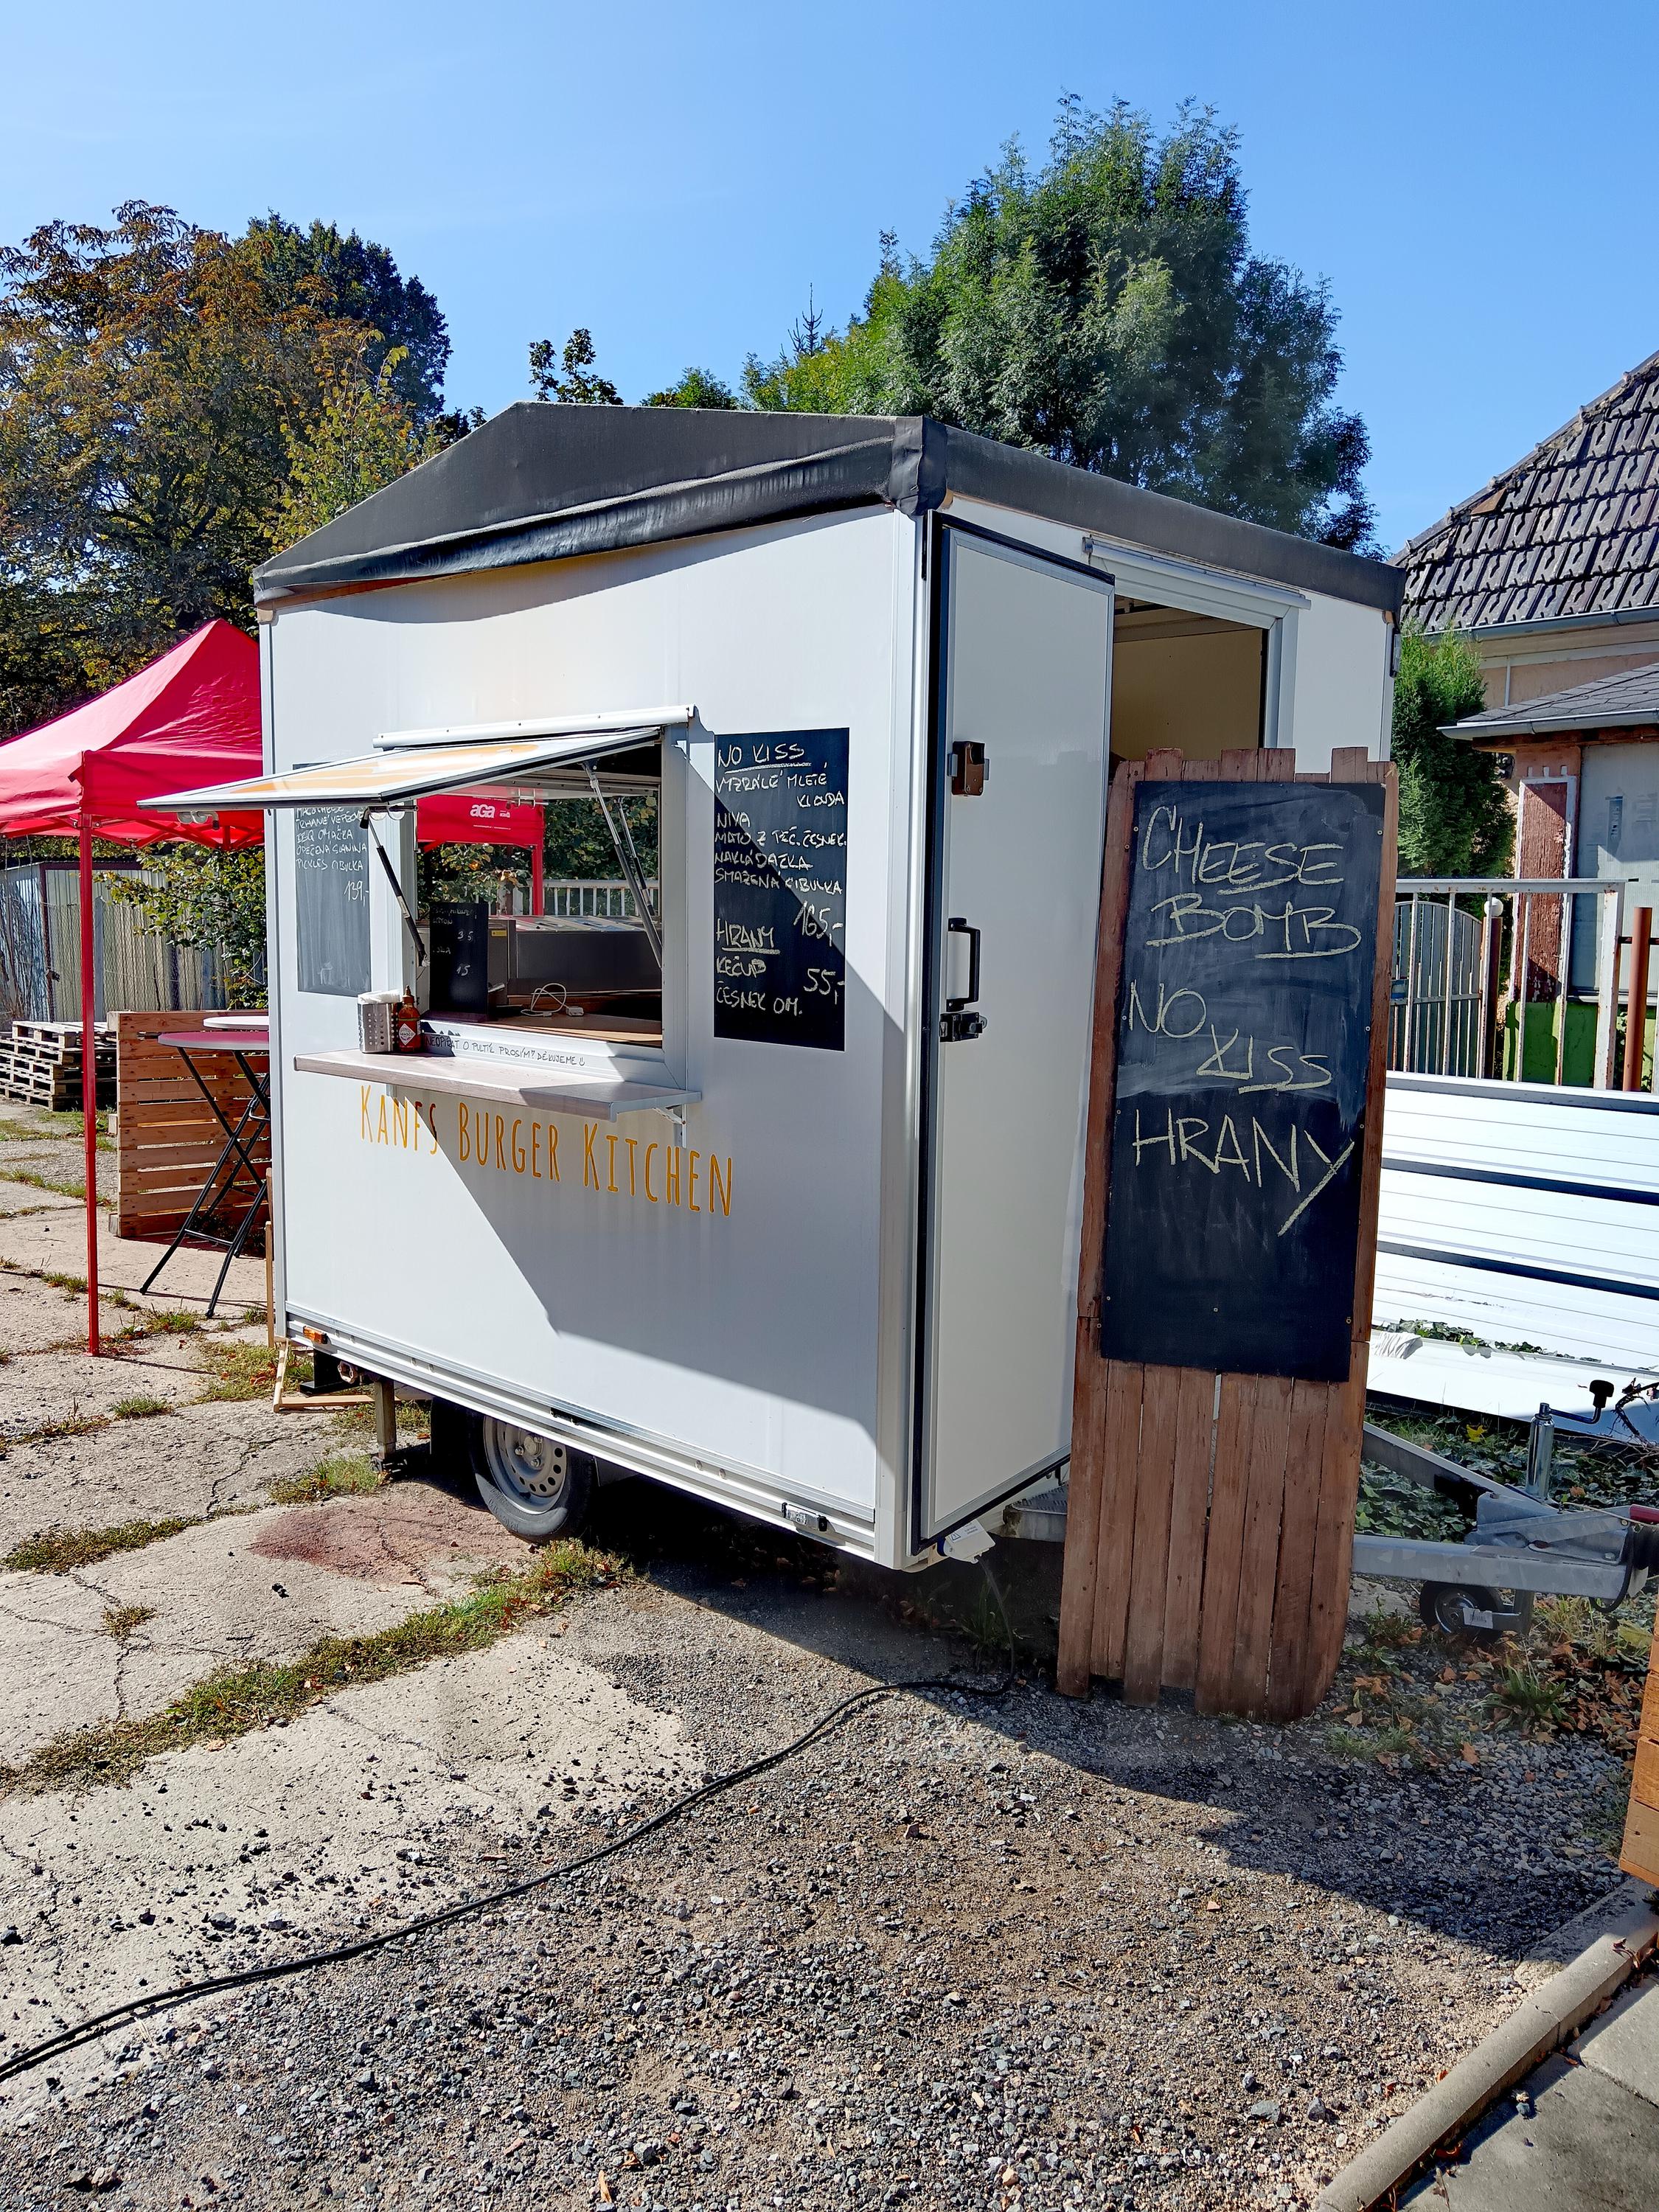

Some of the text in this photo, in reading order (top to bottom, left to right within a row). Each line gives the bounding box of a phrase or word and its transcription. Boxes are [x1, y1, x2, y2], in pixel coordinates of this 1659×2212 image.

[717, 743, 804, 768] NO KISS
[787, 762, 827, 789] MLETÉ
[717, 812, 751, 829] NIVA
[332, 842, 367, 854] SLANINA
[757, 831, 767, 847] Z
[1141, 804, 1345, 889] CHEESE
[296, 858, 328, 871] PICKLES
[344, 880, 369, 908] 139,-
[785, 877, 843, 895] CIBULKA
[716, 918, 775, 949] HRANY
[793, 900, 844, 947] 165,-
[1145, 891, 1362, 959] BOMB
[716, 956, 767, 978] KEČUP
[716, 981, 803, 1017] ČESNEK OM.
[803, 968, 846, 1005] 55,-
[1128, 978, 1207, 1038] NO
[462, 1041, 469, 1050] O
[537, 1051, 577, 1065] DĚKUJEME
[1196, 1023, 1332, 1088] KISS
[458, 1102, 561, 1183] BURGER
[583, 1121, 733, 1217] KITCHEN
[1132, 1107, 1356, 1237] HRANY
